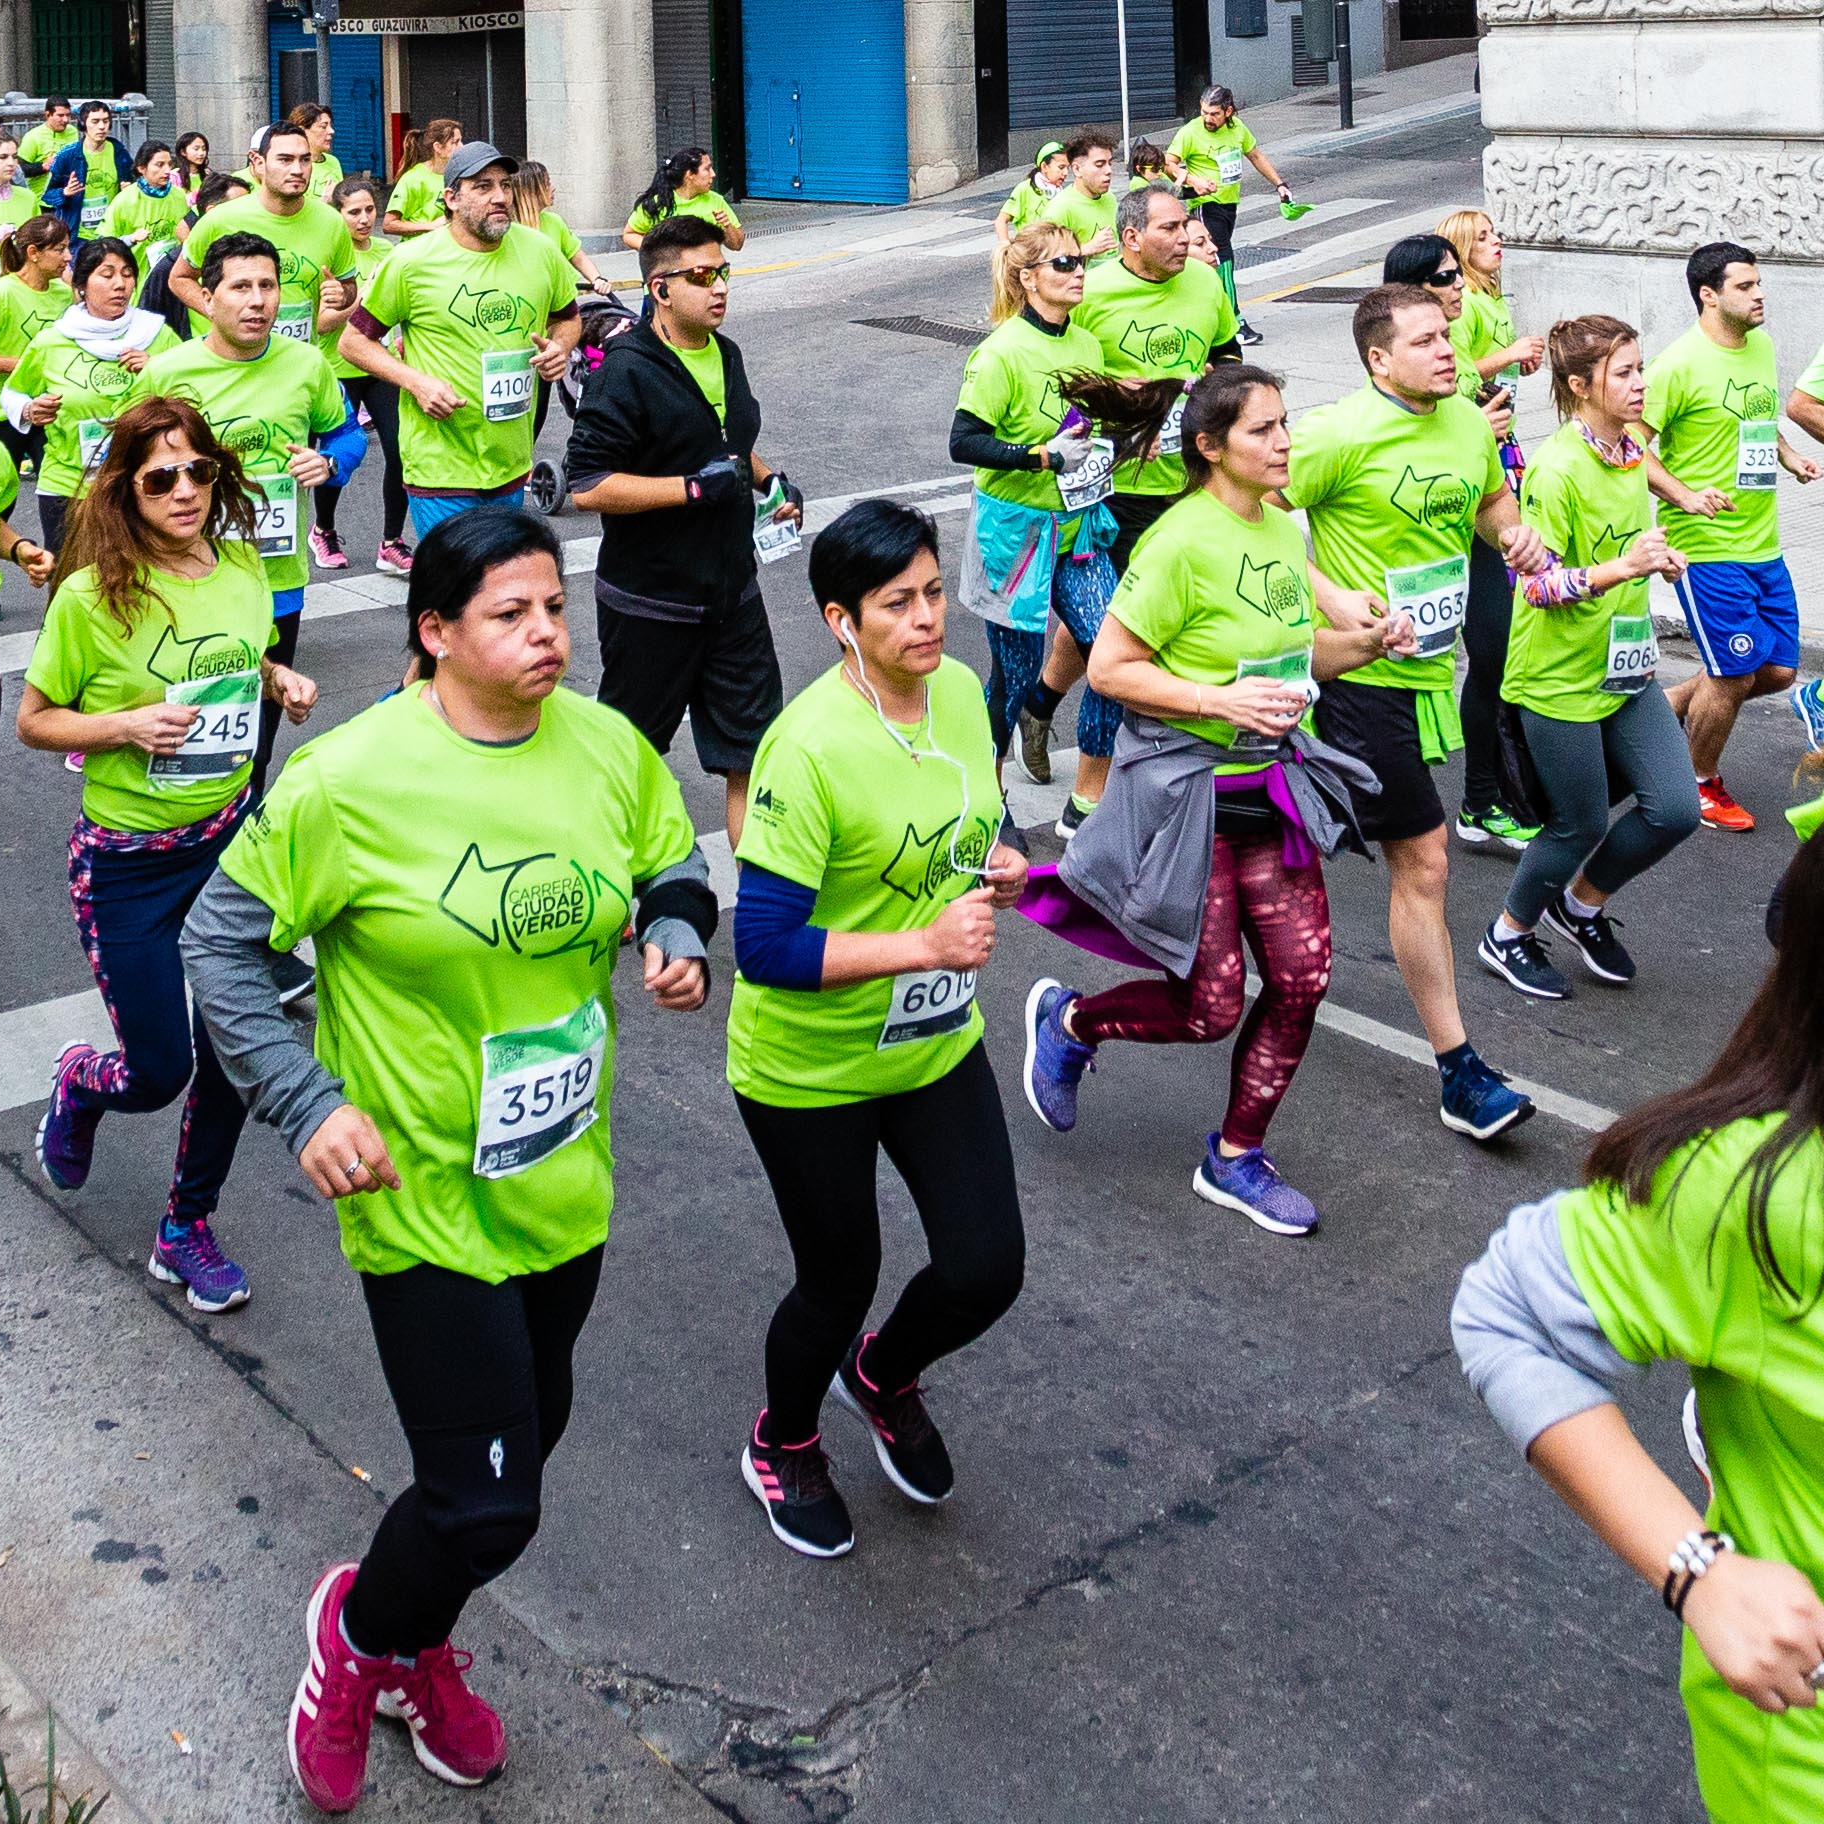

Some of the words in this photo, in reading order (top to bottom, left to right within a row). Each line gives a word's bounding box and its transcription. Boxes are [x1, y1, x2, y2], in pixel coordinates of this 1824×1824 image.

[331, 19, 364, 34] OSCO
[458, 12, 520, 30] KIOSCO
[482, 311, 513, 324] VERDE
[194, 649, 247, 667] CARRERA
[194, 657, 246, 677] CIUDAD
[185, 711, 250, 744] 245
[508, 876, 584, 905] CARRERA
[510, 889, 585, 920] CIUDAD
[511, 905, 584, 940] VERDE
[493, 1049, 525, 1070] VERDE
[498, 1056, 594, 1127] 3519
